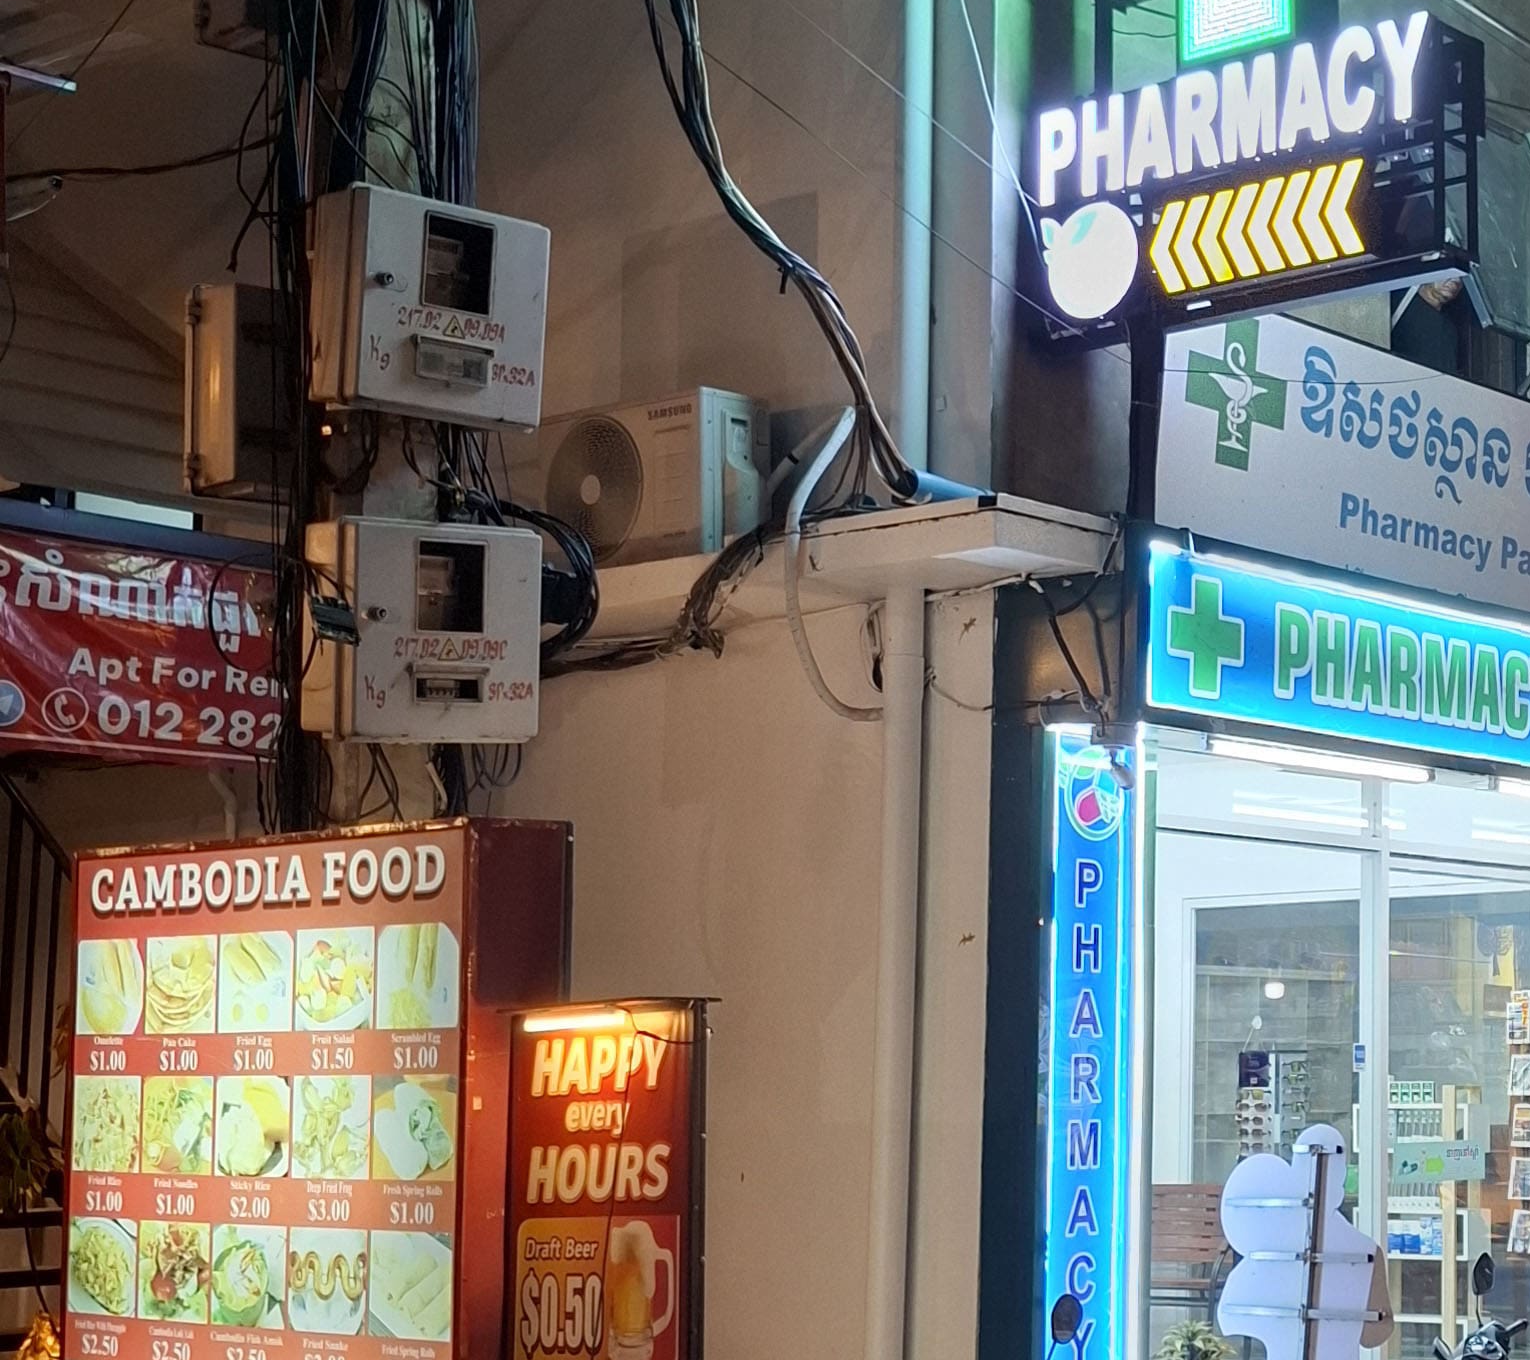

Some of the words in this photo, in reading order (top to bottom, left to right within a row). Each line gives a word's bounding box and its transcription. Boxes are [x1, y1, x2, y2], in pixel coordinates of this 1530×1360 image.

[1038, 11, 1429, 207] PHARMACY
[647, 403, 692, 421] SAMSUNG
[1339, 492, 1492, 572] Pharmacy
[68, 648, 142, 685] Apt
[152, 657, 216, 690] For
[98, 695, 183, 741] 012
[92, 855, 310, 913] CAMBODIA
[322, 844, 446, 901] FOOD
[237, 1037, 256, 1046] Fried
[258, 1036, 272, 1048] Egg
[312, 1034, 332, 1044] Fruit
[334, 1033, 355, 1044] Salad
[90, 1050, 126, 1071] $1.00
[160, 1050, 198, 1071] $1.00
[234, 1048, 274, 1071] $1.00
[312, 1047, 353, 1070] $1.50
[394, 1046, 438, 1069] $1.00
[531, 1036, 668, 1097] HAPPY
[565, 1101, 629, 1138] every
[154, 1178, 172, 1189] Fried
[526, 1143, 670, 1204] HOURS
[230, 1180, 252, 1192] Sticky
[86, 1191, 123, 1212] $1.00
[156, 1193, 195, 1216] $1.00
[230, 1196, 271, 1218] $2.00
[308, 1199, 350, 1221] $3.00
[390, 1202, 434, 1225] $1.00
[526, 1237, 560, 1261] Draft
[565, 1239, 597, 1260] Beer
[520, 1268, 602, 1360] $0.50
[82, 1334, 118, 1356] $2.50
[303, 1338, 323, 1350] Fried
[382, 1344, 398, 1356] Fried
[399, 1346, 419, 1360] Spring
